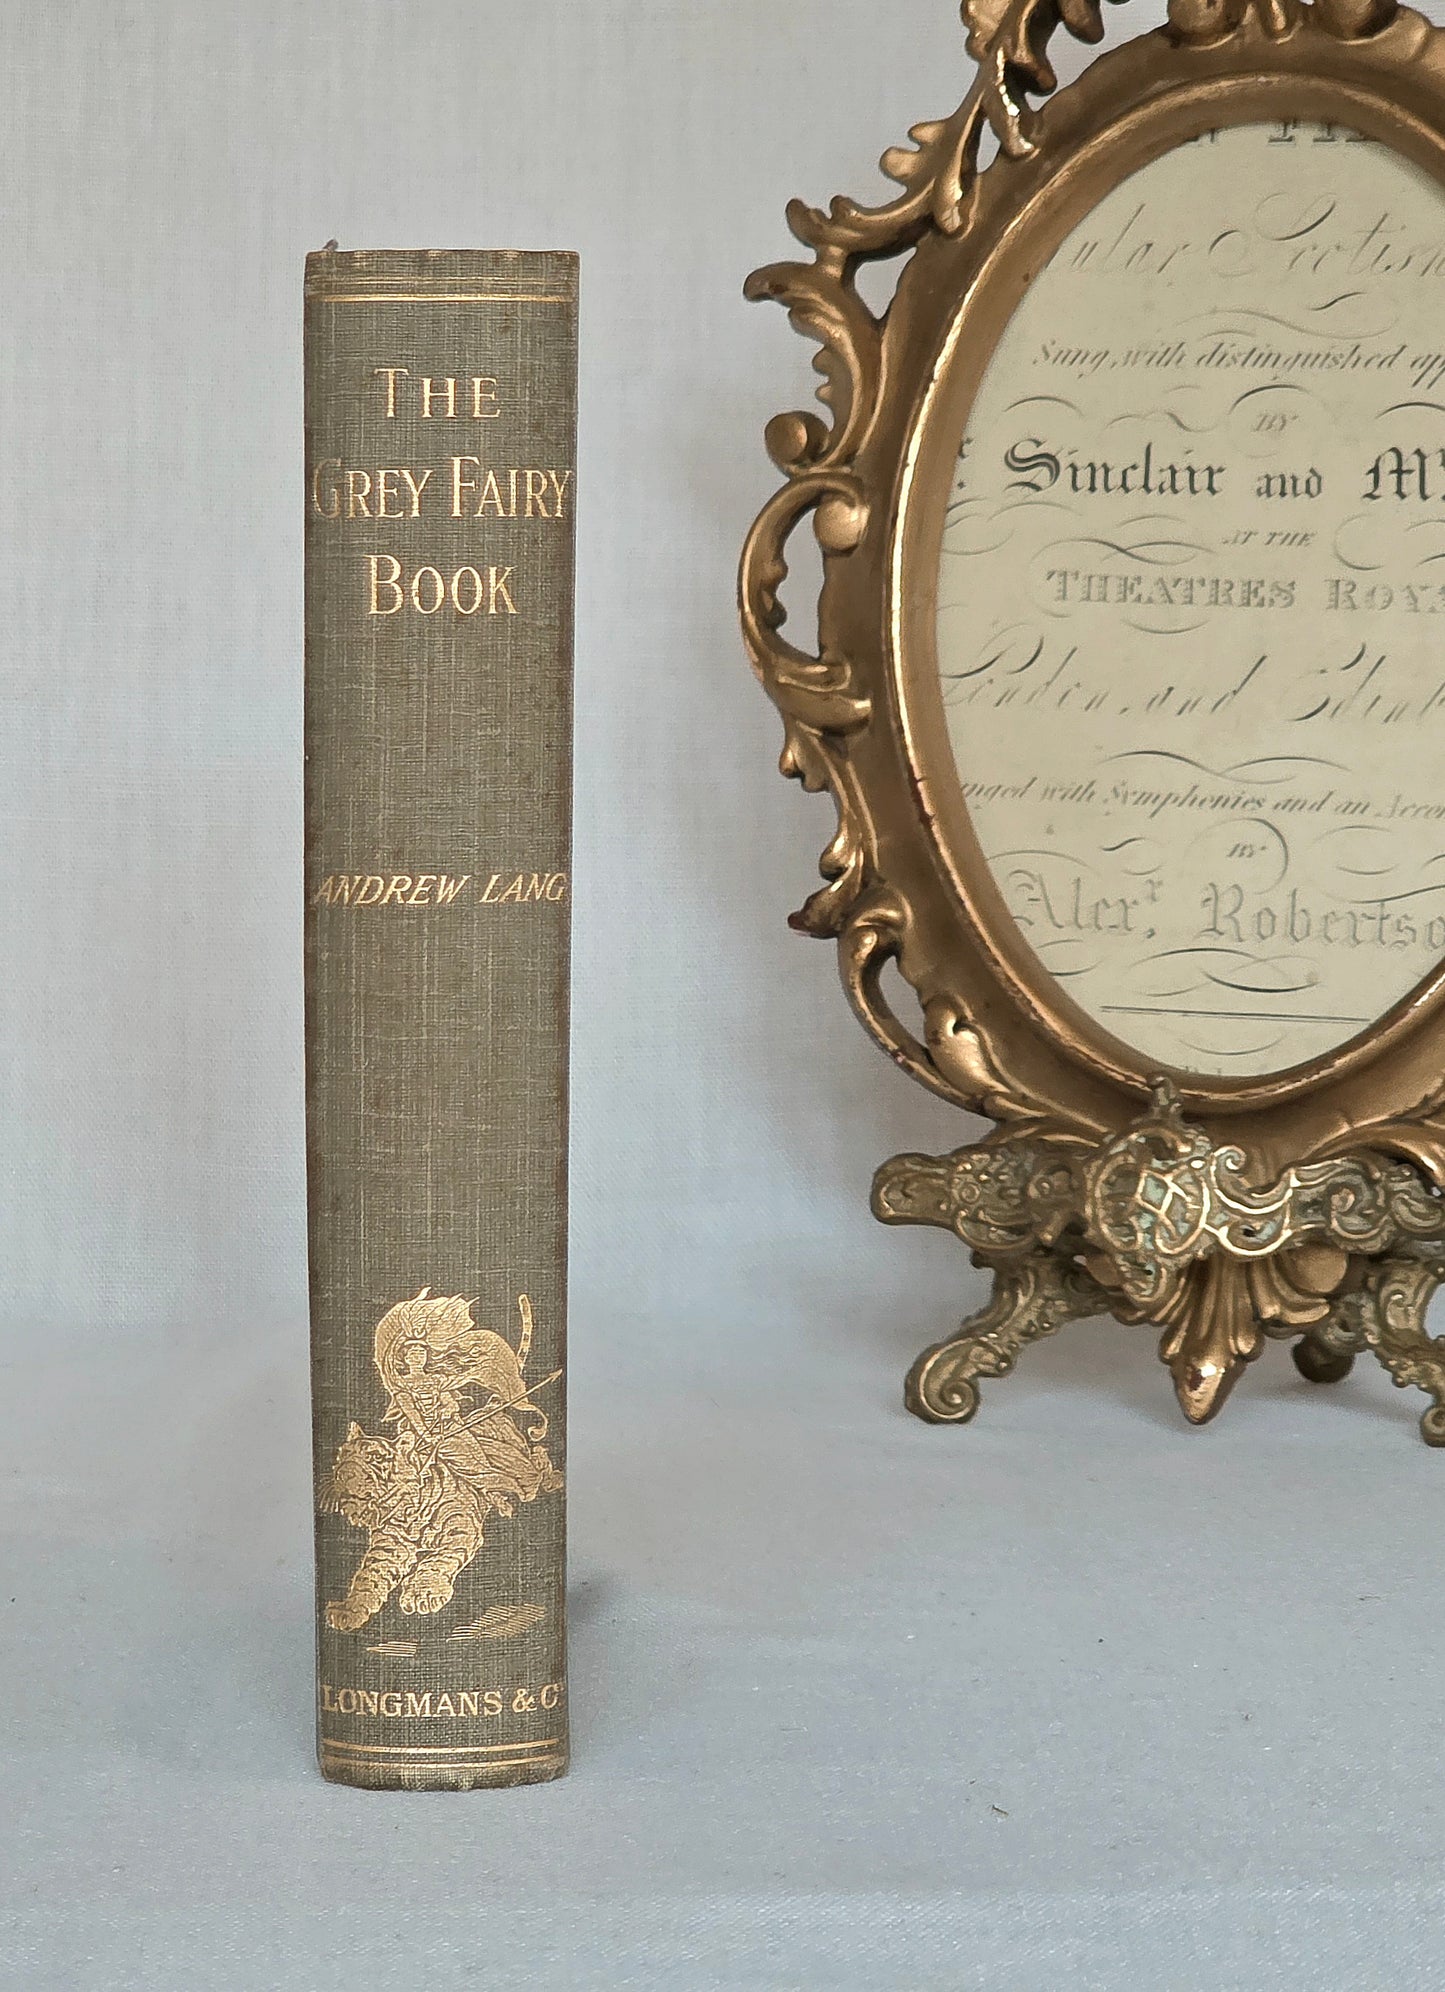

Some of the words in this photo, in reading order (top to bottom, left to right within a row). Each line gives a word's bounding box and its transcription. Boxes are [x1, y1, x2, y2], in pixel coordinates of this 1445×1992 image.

[1121, 341, 1187, 369] with
[1196, 341, 1408, 375] distinguished
[374, 368, 502, 419] THE
[1003, 428, 1226, 498] Sinclair
[1256, 467, 1322, 499] and
[312, 457, 434, 520] GREY
[450, 455, 572, 519] FAIRY
[366, 554, 521, 616] BOOK
[1046, 569, 1298, 609] THEATRES
[1040, 779, 1097, 803] with
[1101, 779, 1266, 820] Symphonies
[1271, 790, 1335, 814] and
[1334, 801, 1370, 815] an
[314, 874, 472, 905] ANDREW
[480, 873, 567, 903] LANG
[320, 1684, 503, 1718] LONGMANS
[512, 1687, 538, 1713] &
